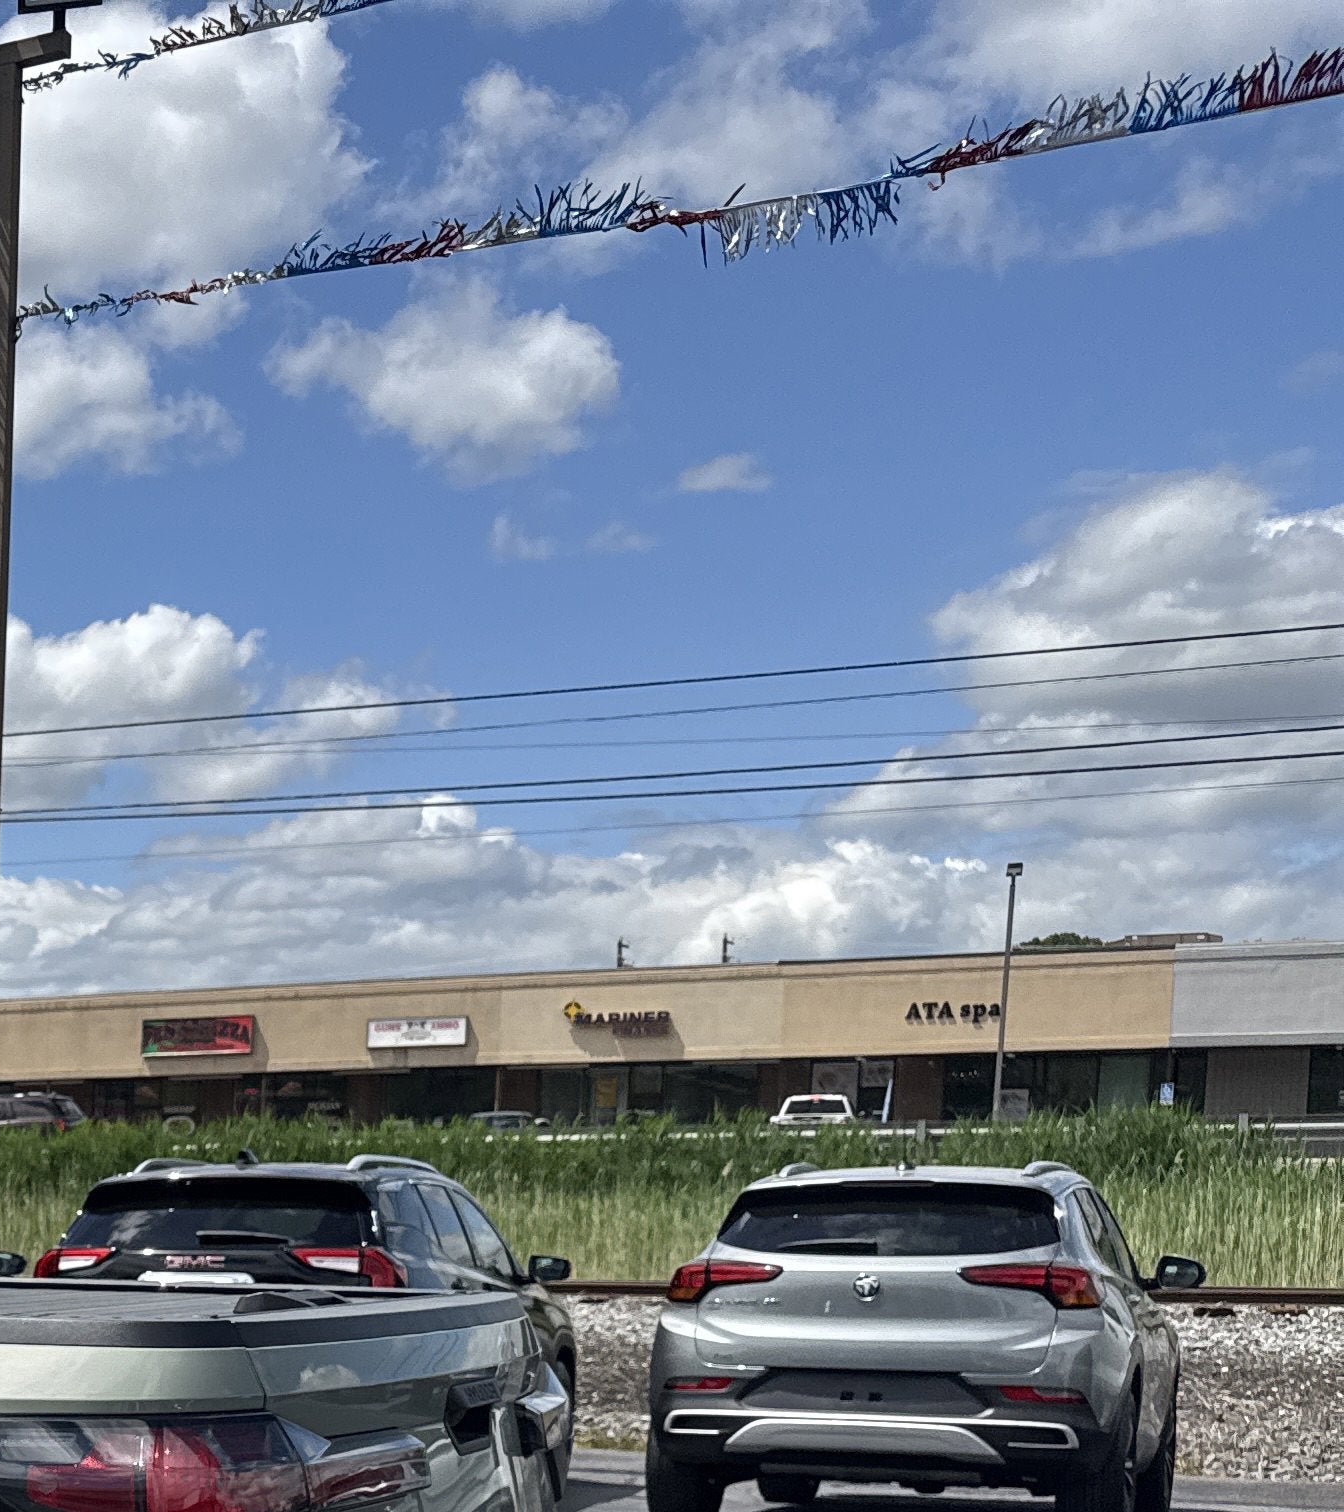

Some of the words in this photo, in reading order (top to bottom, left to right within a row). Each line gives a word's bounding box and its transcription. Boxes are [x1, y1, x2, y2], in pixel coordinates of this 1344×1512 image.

[573, 1010, 671, 1025] MARINER
[904, 1001, 955, 1020] ATA
[959, 1003, 1001, 1023] spa
[165, 1255, 226, 1269] GMC
